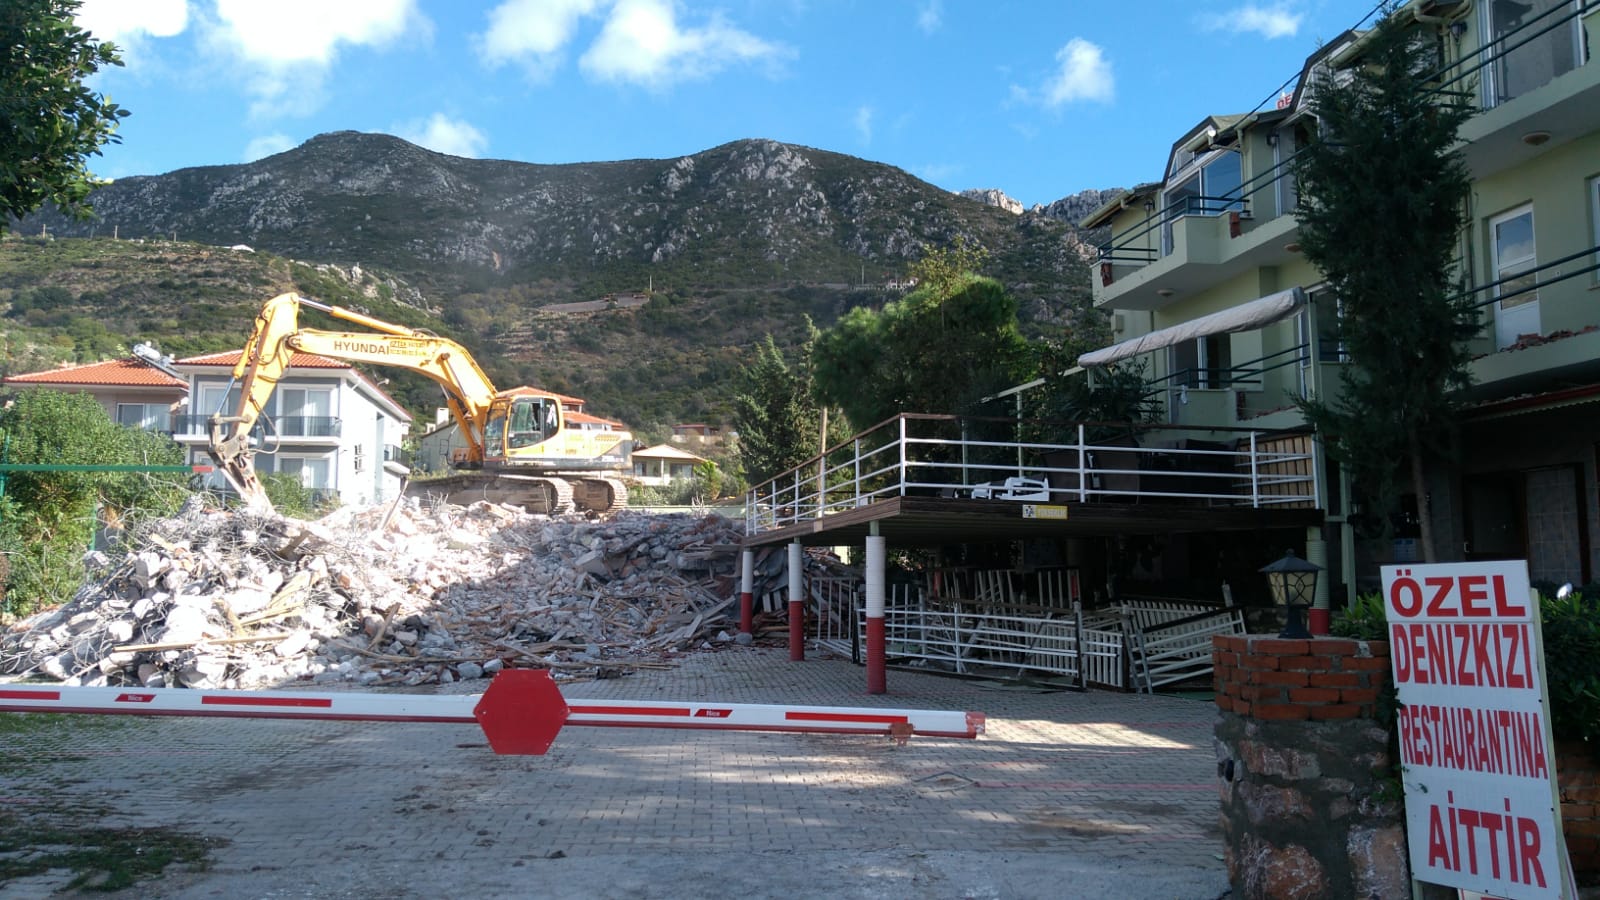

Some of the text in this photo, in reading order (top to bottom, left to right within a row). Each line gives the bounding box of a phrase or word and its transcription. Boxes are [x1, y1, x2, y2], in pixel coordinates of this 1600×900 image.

[334, 341, 390, 355] HYUNDAI
[1390, 569, 1525, 617] ÖZEL
[1400, 704, 1548, 779] RESTAURANTINA
[1428, 790, 1547, 889] AİTTİR
